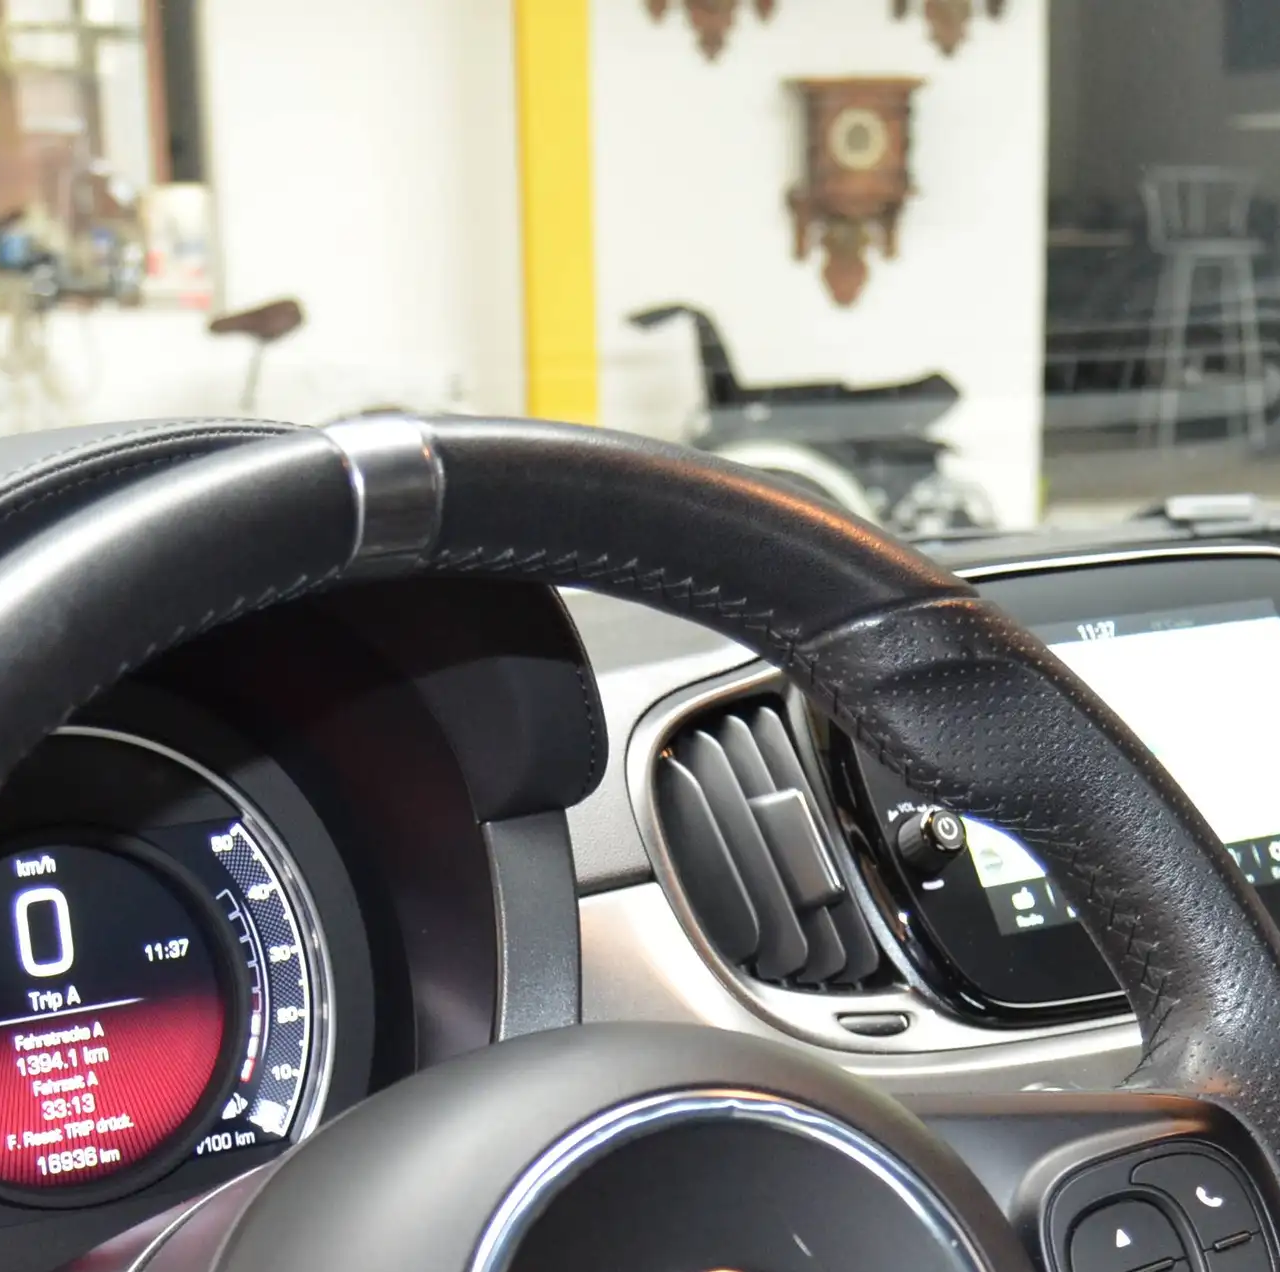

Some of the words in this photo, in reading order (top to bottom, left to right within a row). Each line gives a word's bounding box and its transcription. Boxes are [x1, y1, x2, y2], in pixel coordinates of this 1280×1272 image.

[1076, 620, 1116, 642] 11:37
[16, 855, 57, 877] km/h
[15, 887, 74, 978] 0
[144, 937, 189, 962] 11:37
[28, 991, 63, 1012] Trip
[67, 985, 81, 1005] A
[93, 1021, 105, 1038] A
[16, 1048, 78, 1077] 1394.1
[83, 1045, 109, 1065] km
[271, 1063, 292, 1081] 10
[86, 1070, 99, 1088] A
[41, 1092, 96, 1121] 33:13
[64, 1119, 95, 1140] TRIP
[235, 1131, 256, 1148] km
[99, 1148, 121, 1164] km
